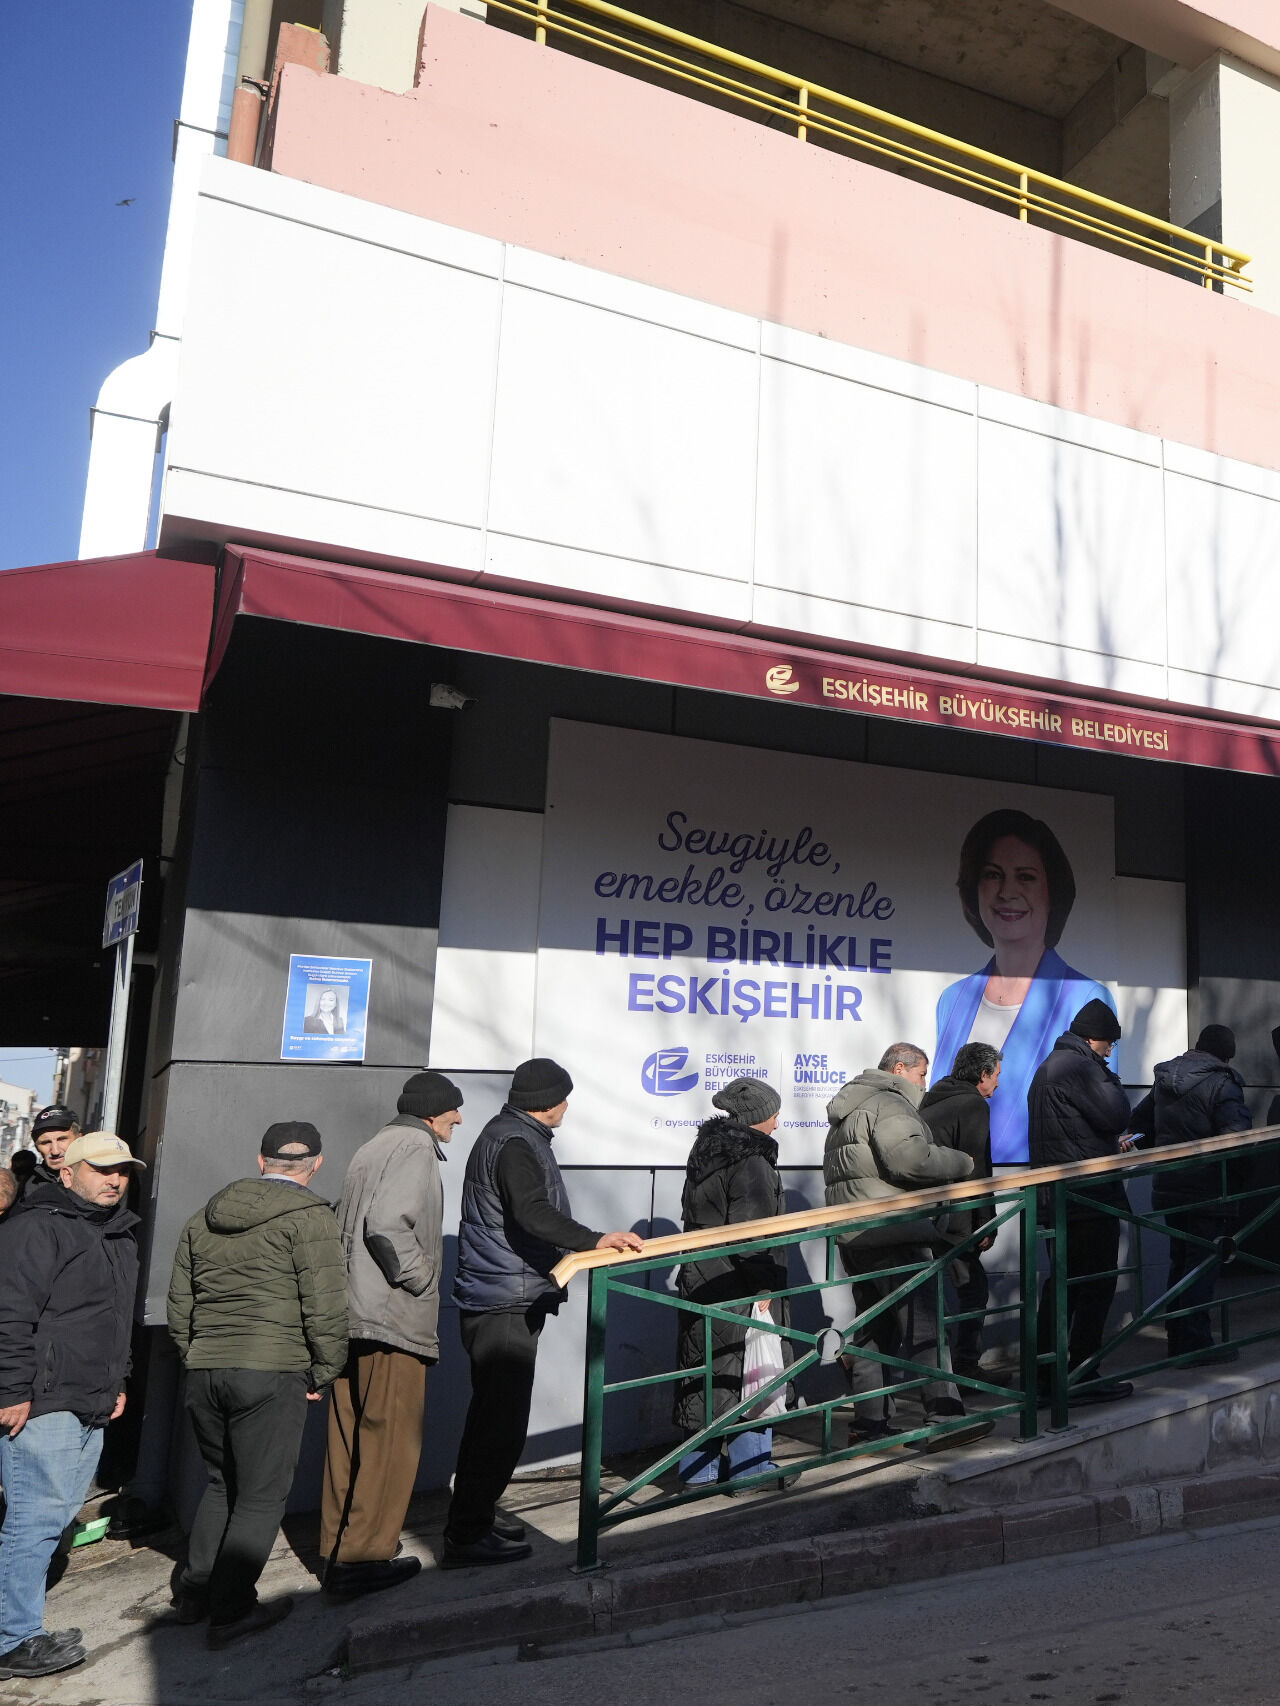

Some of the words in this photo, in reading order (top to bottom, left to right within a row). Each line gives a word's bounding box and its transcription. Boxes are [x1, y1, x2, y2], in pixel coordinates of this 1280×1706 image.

[822, 677, 928, 712] ESKİŞEHİR
[939, 694, 1062, 733] BÜYÜKŞEHİR
[1071, 717, 1169, 751] BELEDİYESİ
[658, 811, 841, 877] Sevgiyle,
[594, 864, 755, 917] emekle,
[764, 878, 896, 920] özenle
[595, 917, 693, 960] HEP
[707, 919, 892, 974] BİRLİKLE
[628, 968, 862, 1023] ESKİŞEHİR
[705, 1052, 756, 1065] ESKİŞEHİR
[794, 1053, 828, 1069] AYŞE
[794, 1066, 847, 1083] ÜNLÜCE
[705, 1081, 728, 1091] BELE
[665, 1118, 704, 1128] ayseunl
[783, 1119, 830, 1128] ayseunluc
